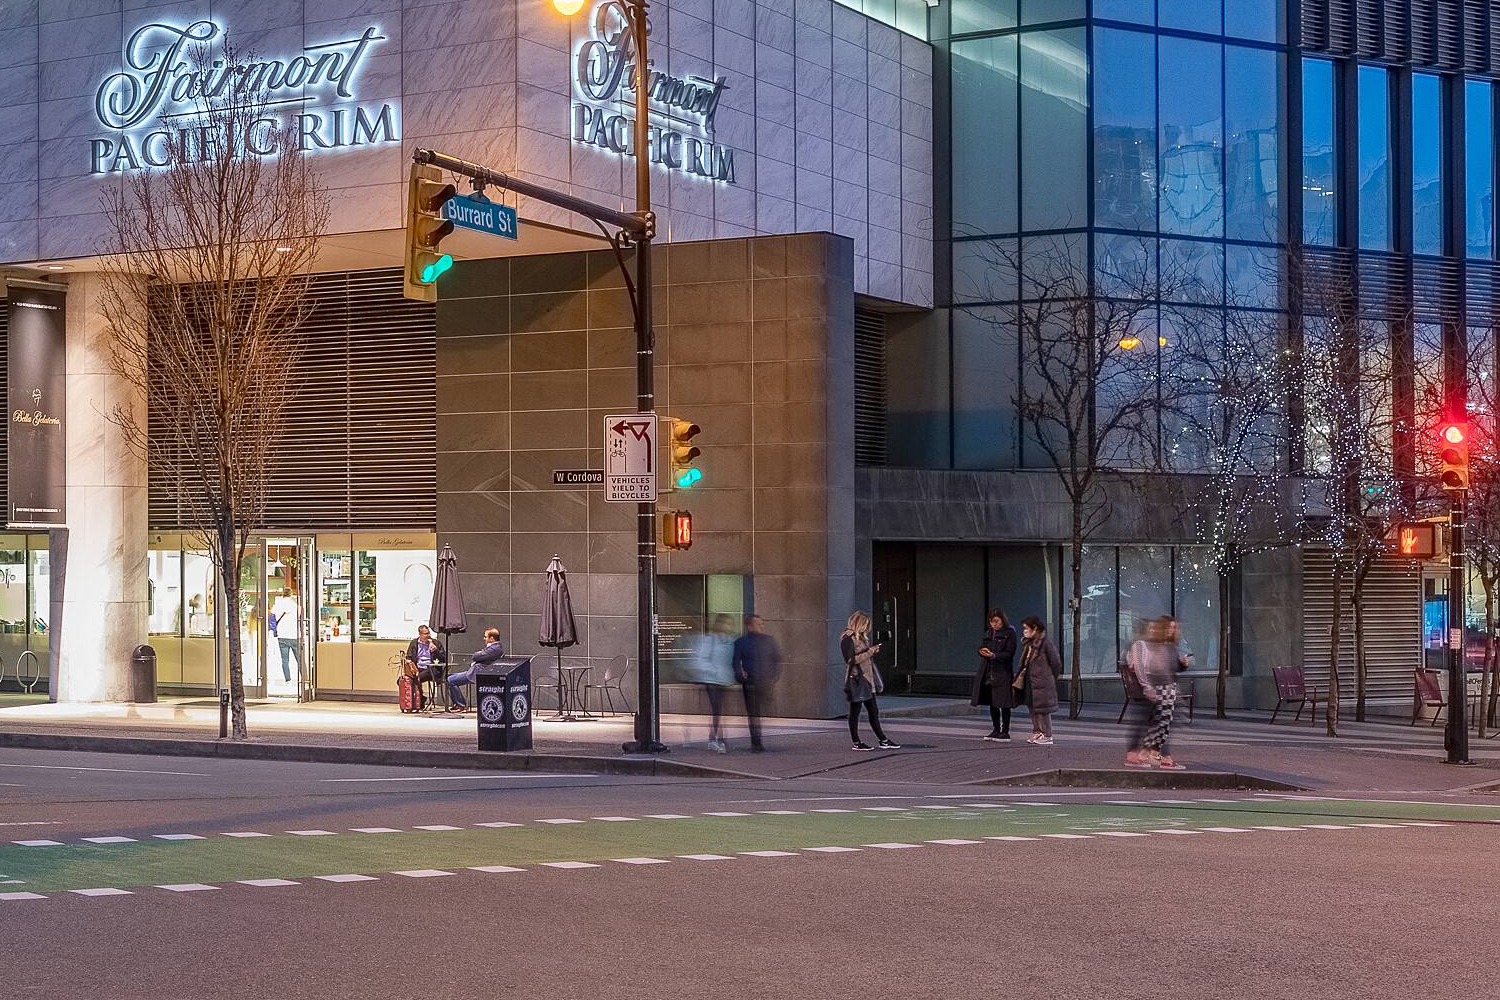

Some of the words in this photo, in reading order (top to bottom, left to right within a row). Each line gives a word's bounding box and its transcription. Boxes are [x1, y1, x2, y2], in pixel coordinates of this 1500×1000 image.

[96, 20, 386, 129] Fairmont
[299, 103, 400, 151] RIM
[685, 137, 737, 184] RIM
[447, 198, 494, 229] Burrard
[498, 210, 512, 233] St
[556, 473, 565, 482] W
[567, 472, 602, 482] Cordova
